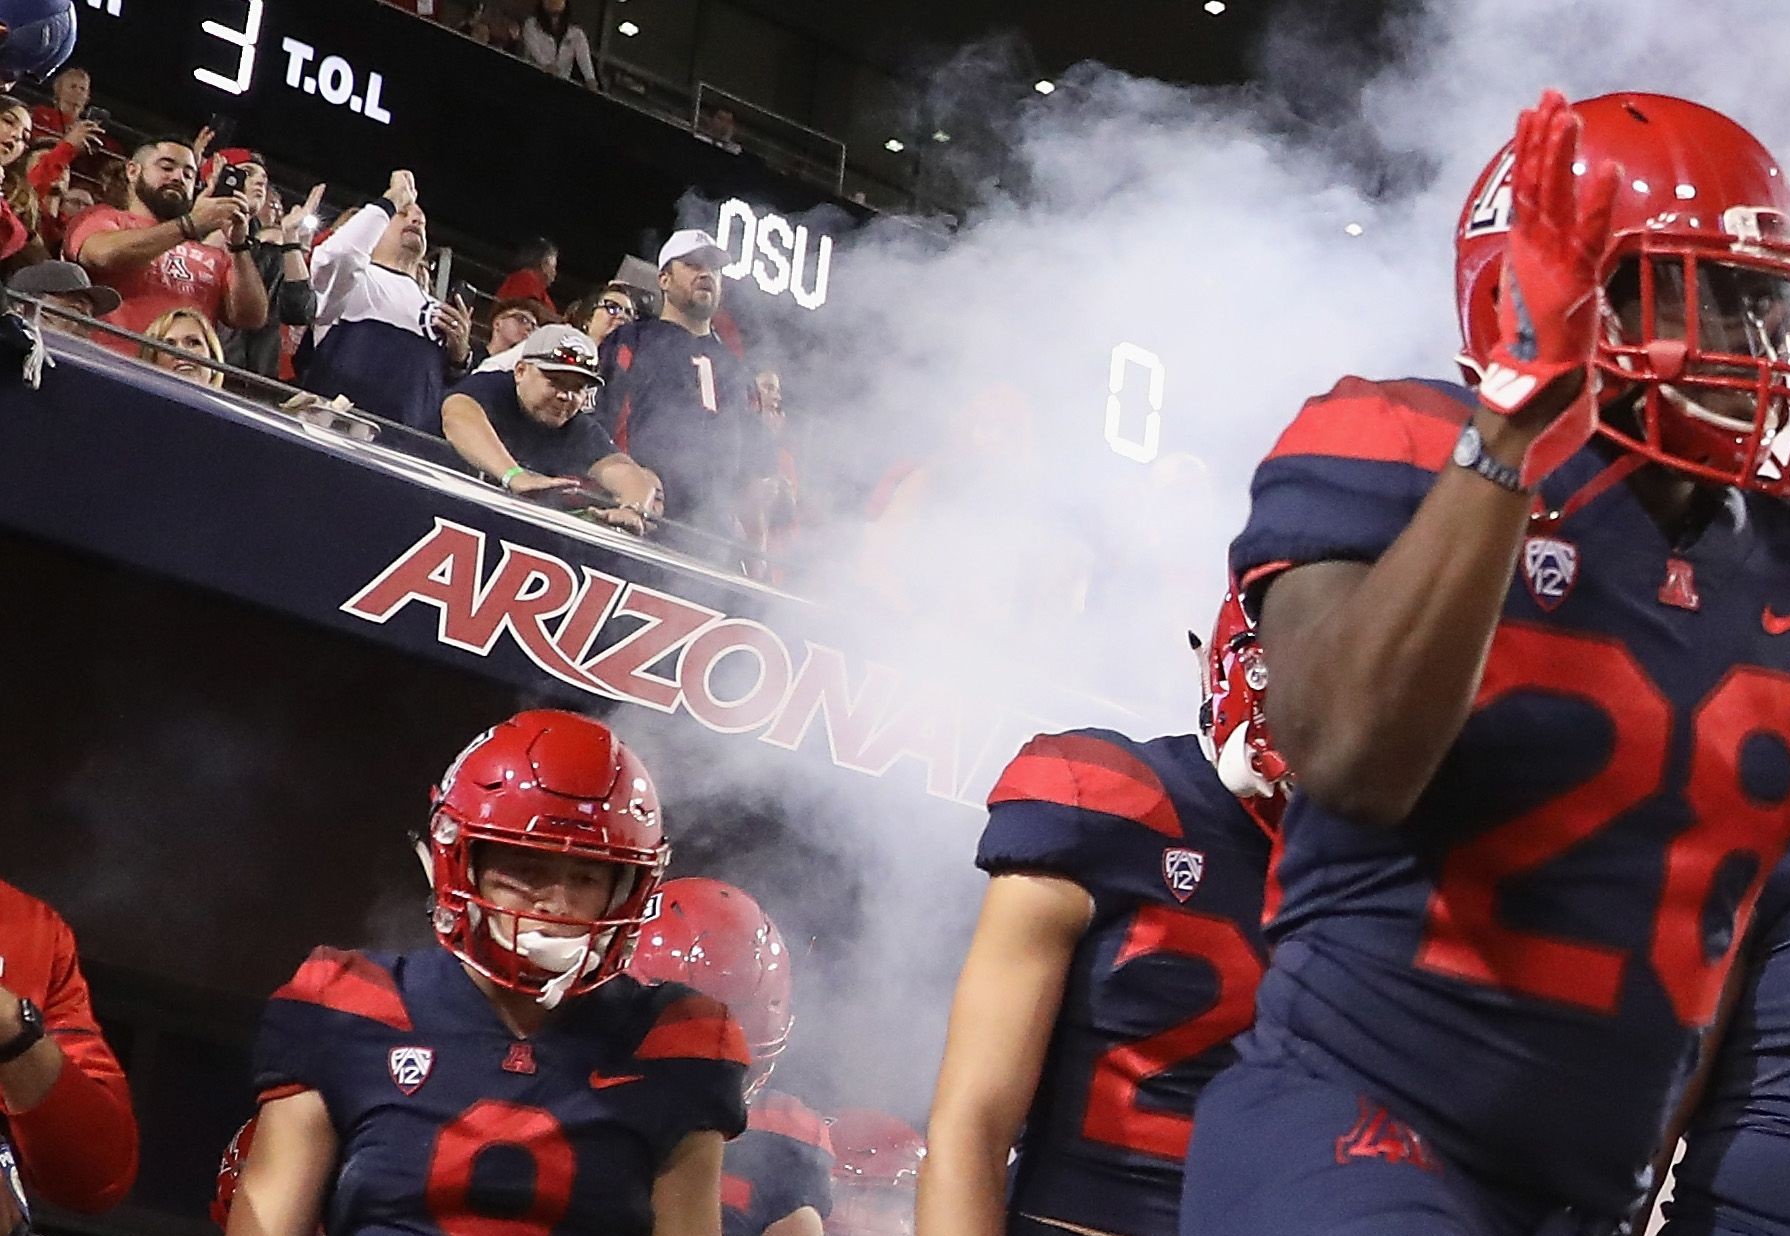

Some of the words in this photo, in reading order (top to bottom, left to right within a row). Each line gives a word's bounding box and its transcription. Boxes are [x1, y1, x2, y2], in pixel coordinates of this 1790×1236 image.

[282, 36, 392, 126] T.O.L
[717, 197, 833, 311] OSU
[690, 354, 718, 413] 1
[1525, 539, 1576, 584] PAC
[1535, 567, 1564, 597] 12
[340, 515, 968, 802] ARIZONA
[1165, 850, 1204, 882] PAC
[1172, 870, 1194, 890] 12
[391, 1048, 433, 1075] PAC
[398, 1066, 421, 1085] 12
